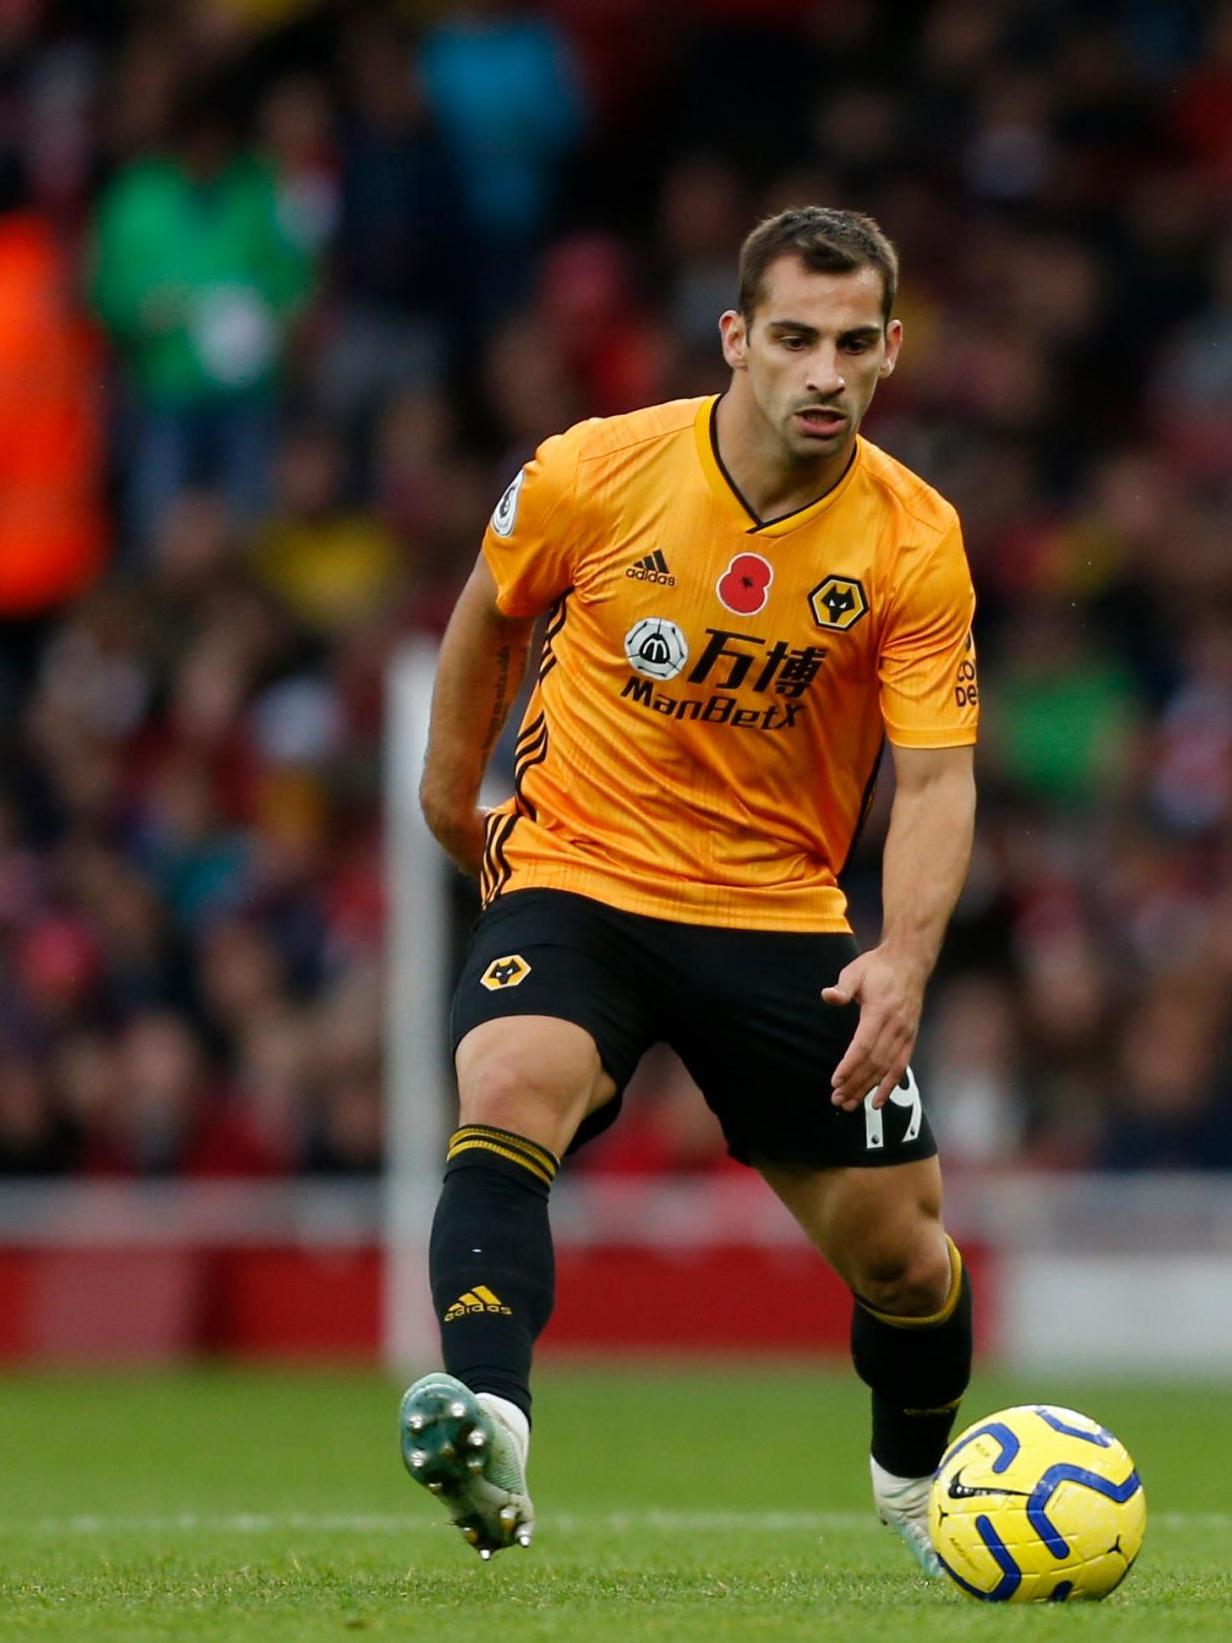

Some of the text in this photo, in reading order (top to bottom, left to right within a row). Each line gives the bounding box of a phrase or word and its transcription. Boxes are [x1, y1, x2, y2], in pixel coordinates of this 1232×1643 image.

[626, 568, 676, 586] adidas
[687, 628, 828, 698] 万博
[620, 676, 803, 730] ManBetX
[864, 1064, 922, 1149] 19
[444, 1303, 512, 1322] adidas
